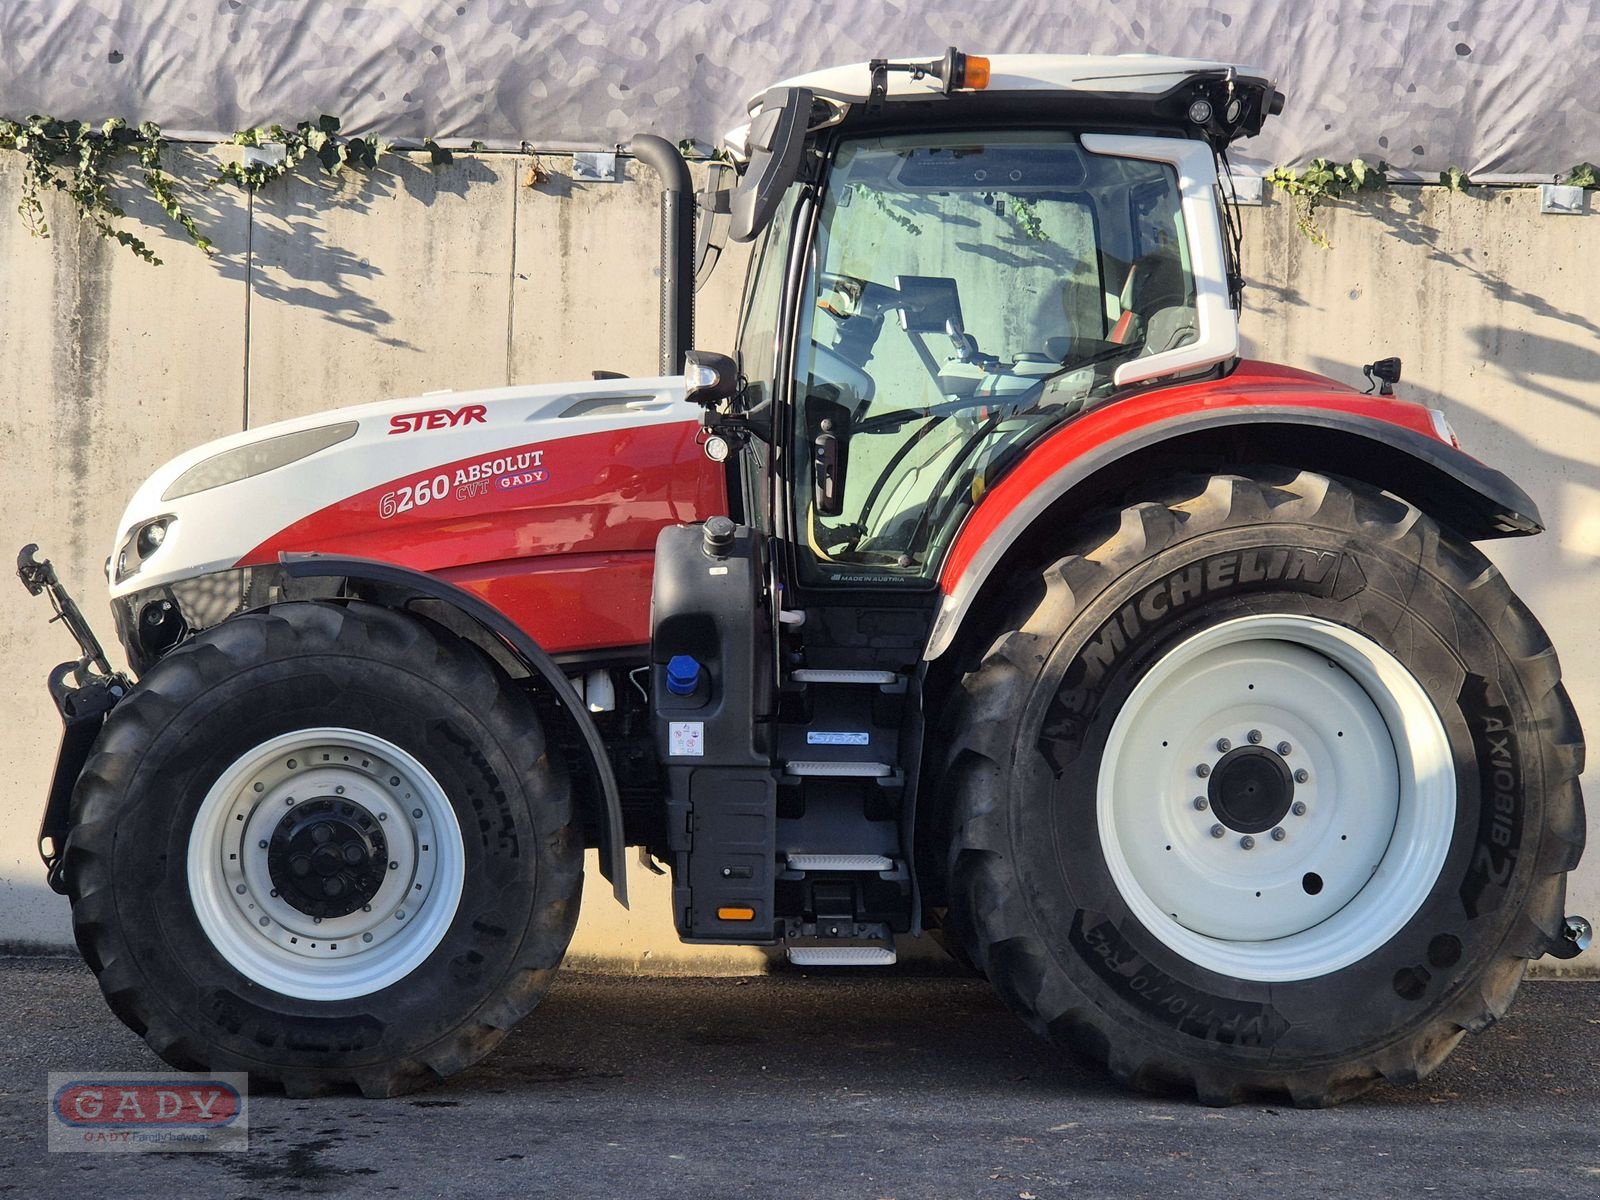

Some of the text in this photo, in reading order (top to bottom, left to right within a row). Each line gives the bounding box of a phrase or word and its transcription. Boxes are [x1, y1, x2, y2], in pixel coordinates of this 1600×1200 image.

[388, 404, 488, 435] STEYR
[379, 450, 544, 520] 6260 ABSOLUT
[455, 480, 490, 501] CVT
[500, 471, 544, 488] GADY
[1079, 550, 1337, 682] MICHELIN
[1483, 714, 1516, 847] AXIOBIB
